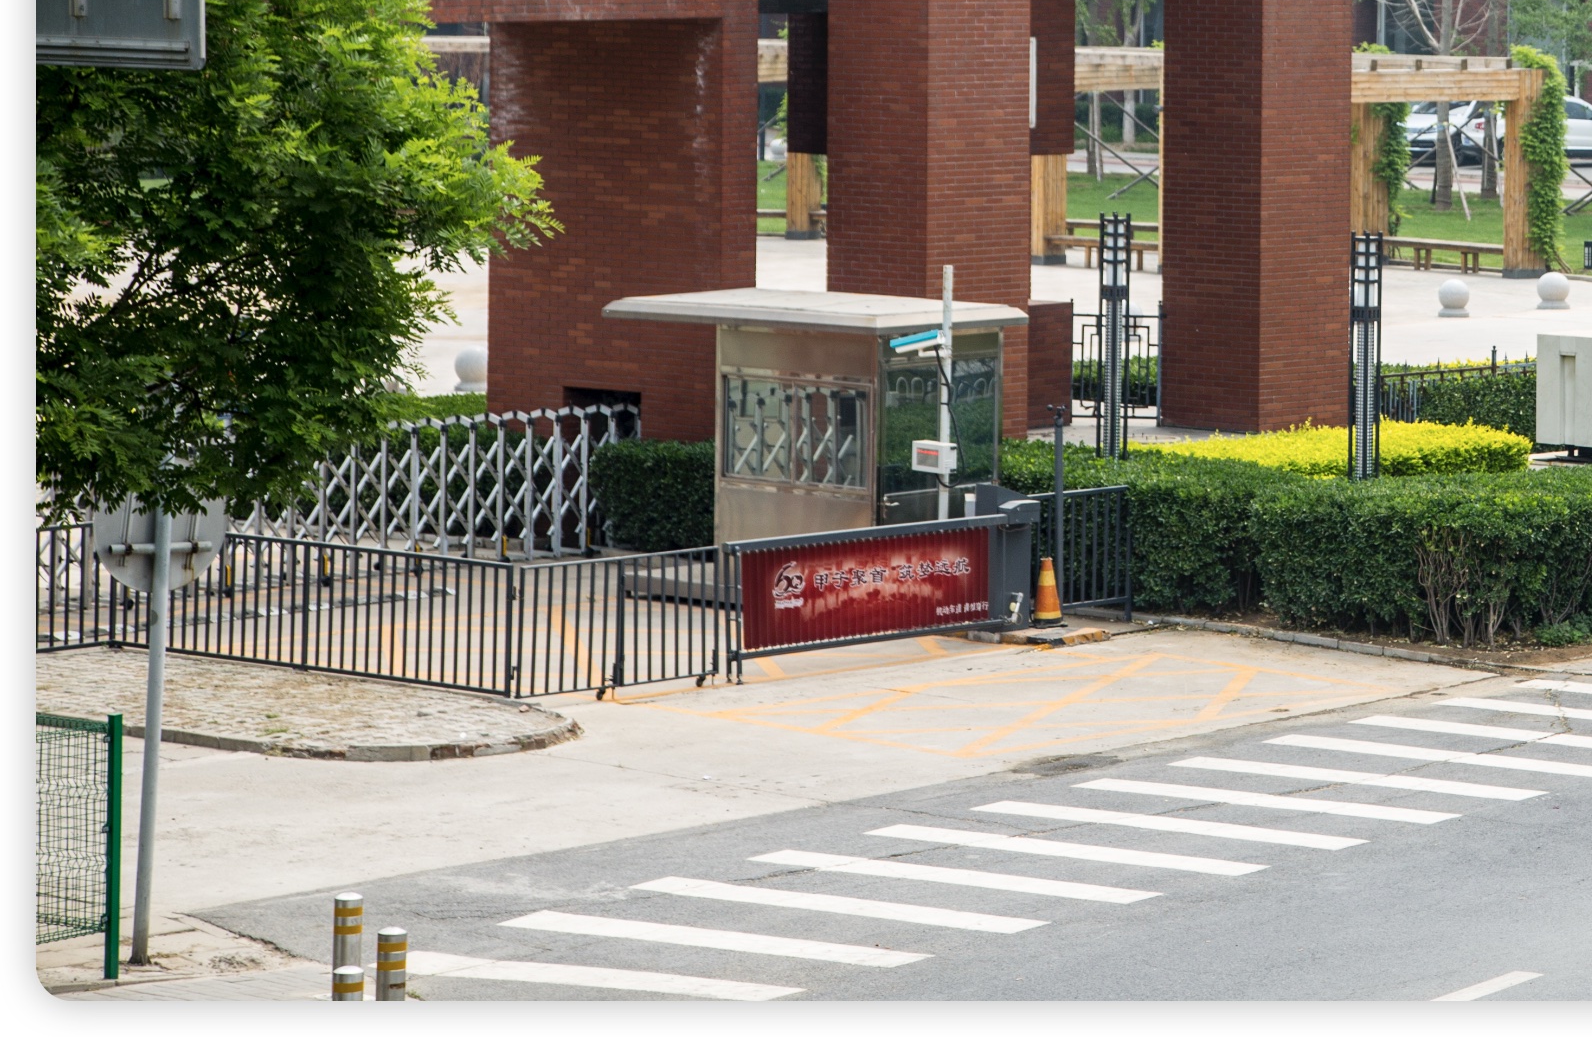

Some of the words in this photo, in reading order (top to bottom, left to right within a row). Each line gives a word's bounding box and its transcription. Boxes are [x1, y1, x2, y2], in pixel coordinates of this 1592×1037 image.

[814, 566, 887, 592] 甲子聚首
[898, 557, 971, 581] 筑梦远航
